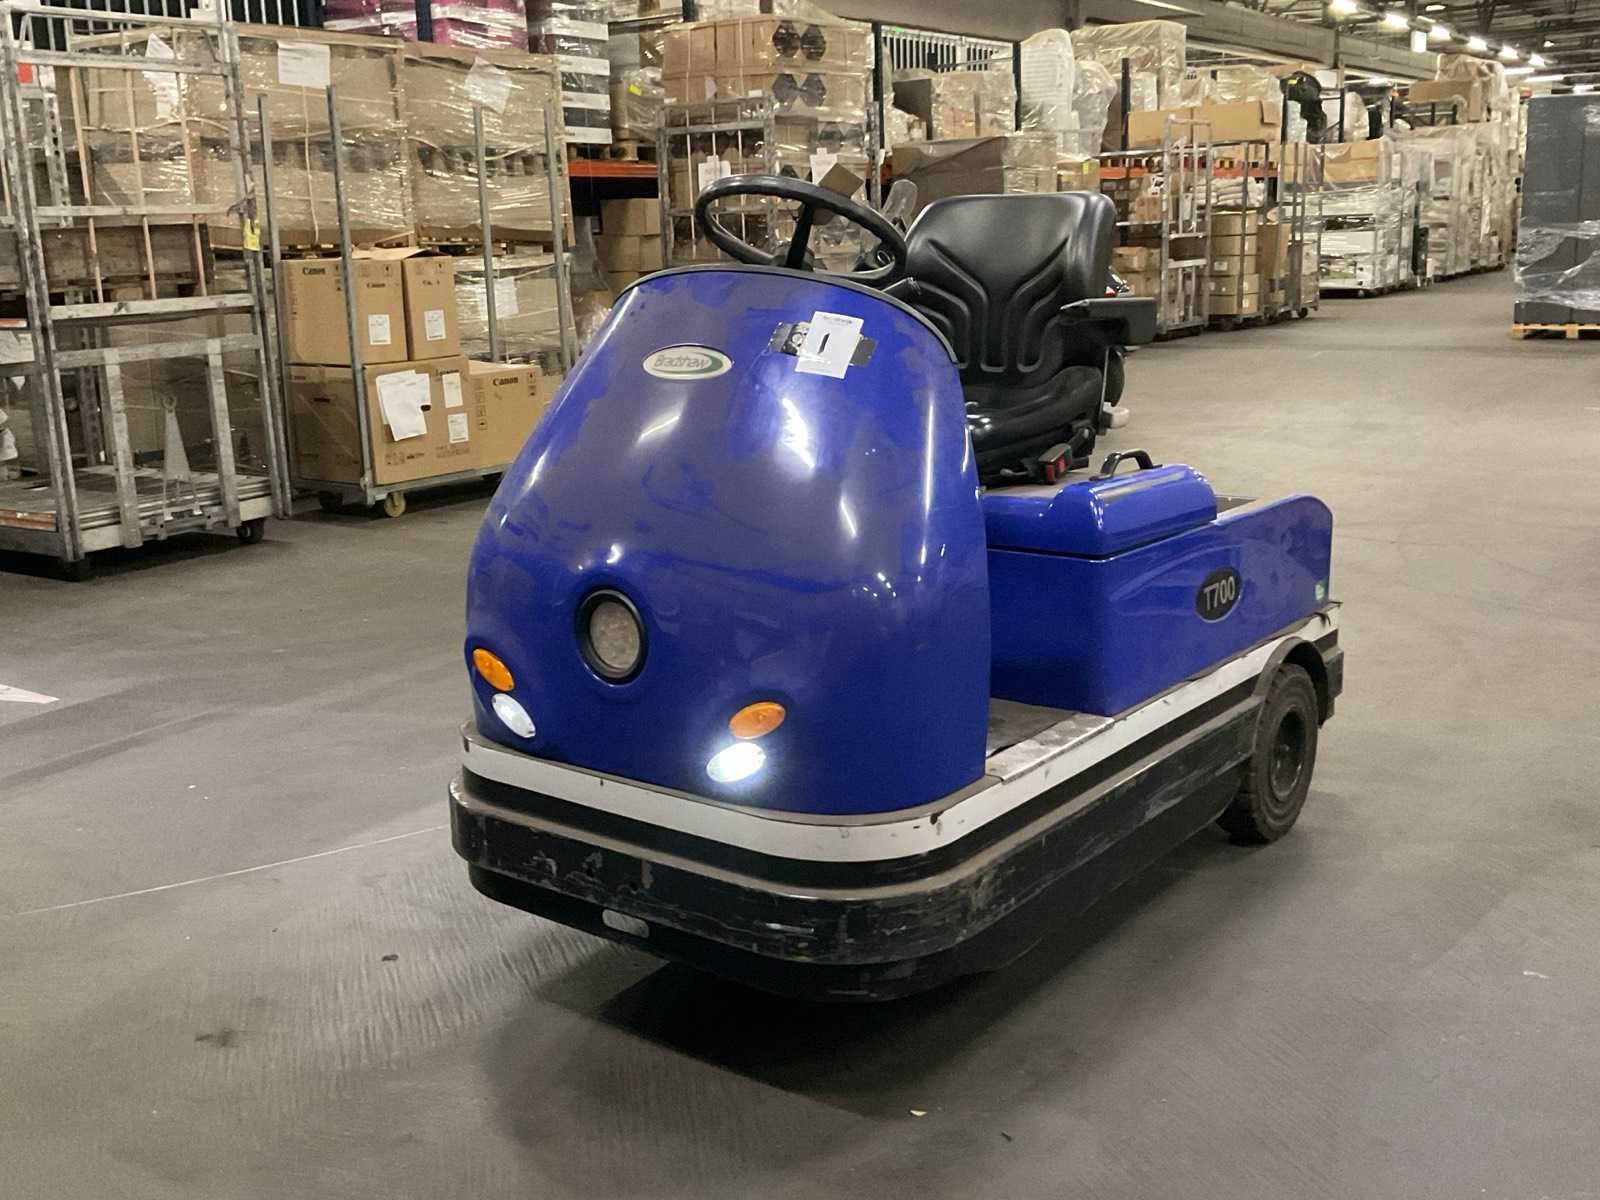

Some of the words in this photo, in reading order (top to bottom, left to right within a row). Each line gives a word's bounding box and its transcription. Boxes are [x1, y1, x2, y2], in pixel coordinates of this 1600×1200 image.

[302, 266, 326, 276] Canon
[654, 353, 709, 369] Bradshaw
[492, 377, 519, 387] Canon
[1203, 575, 1235, 611] T700
